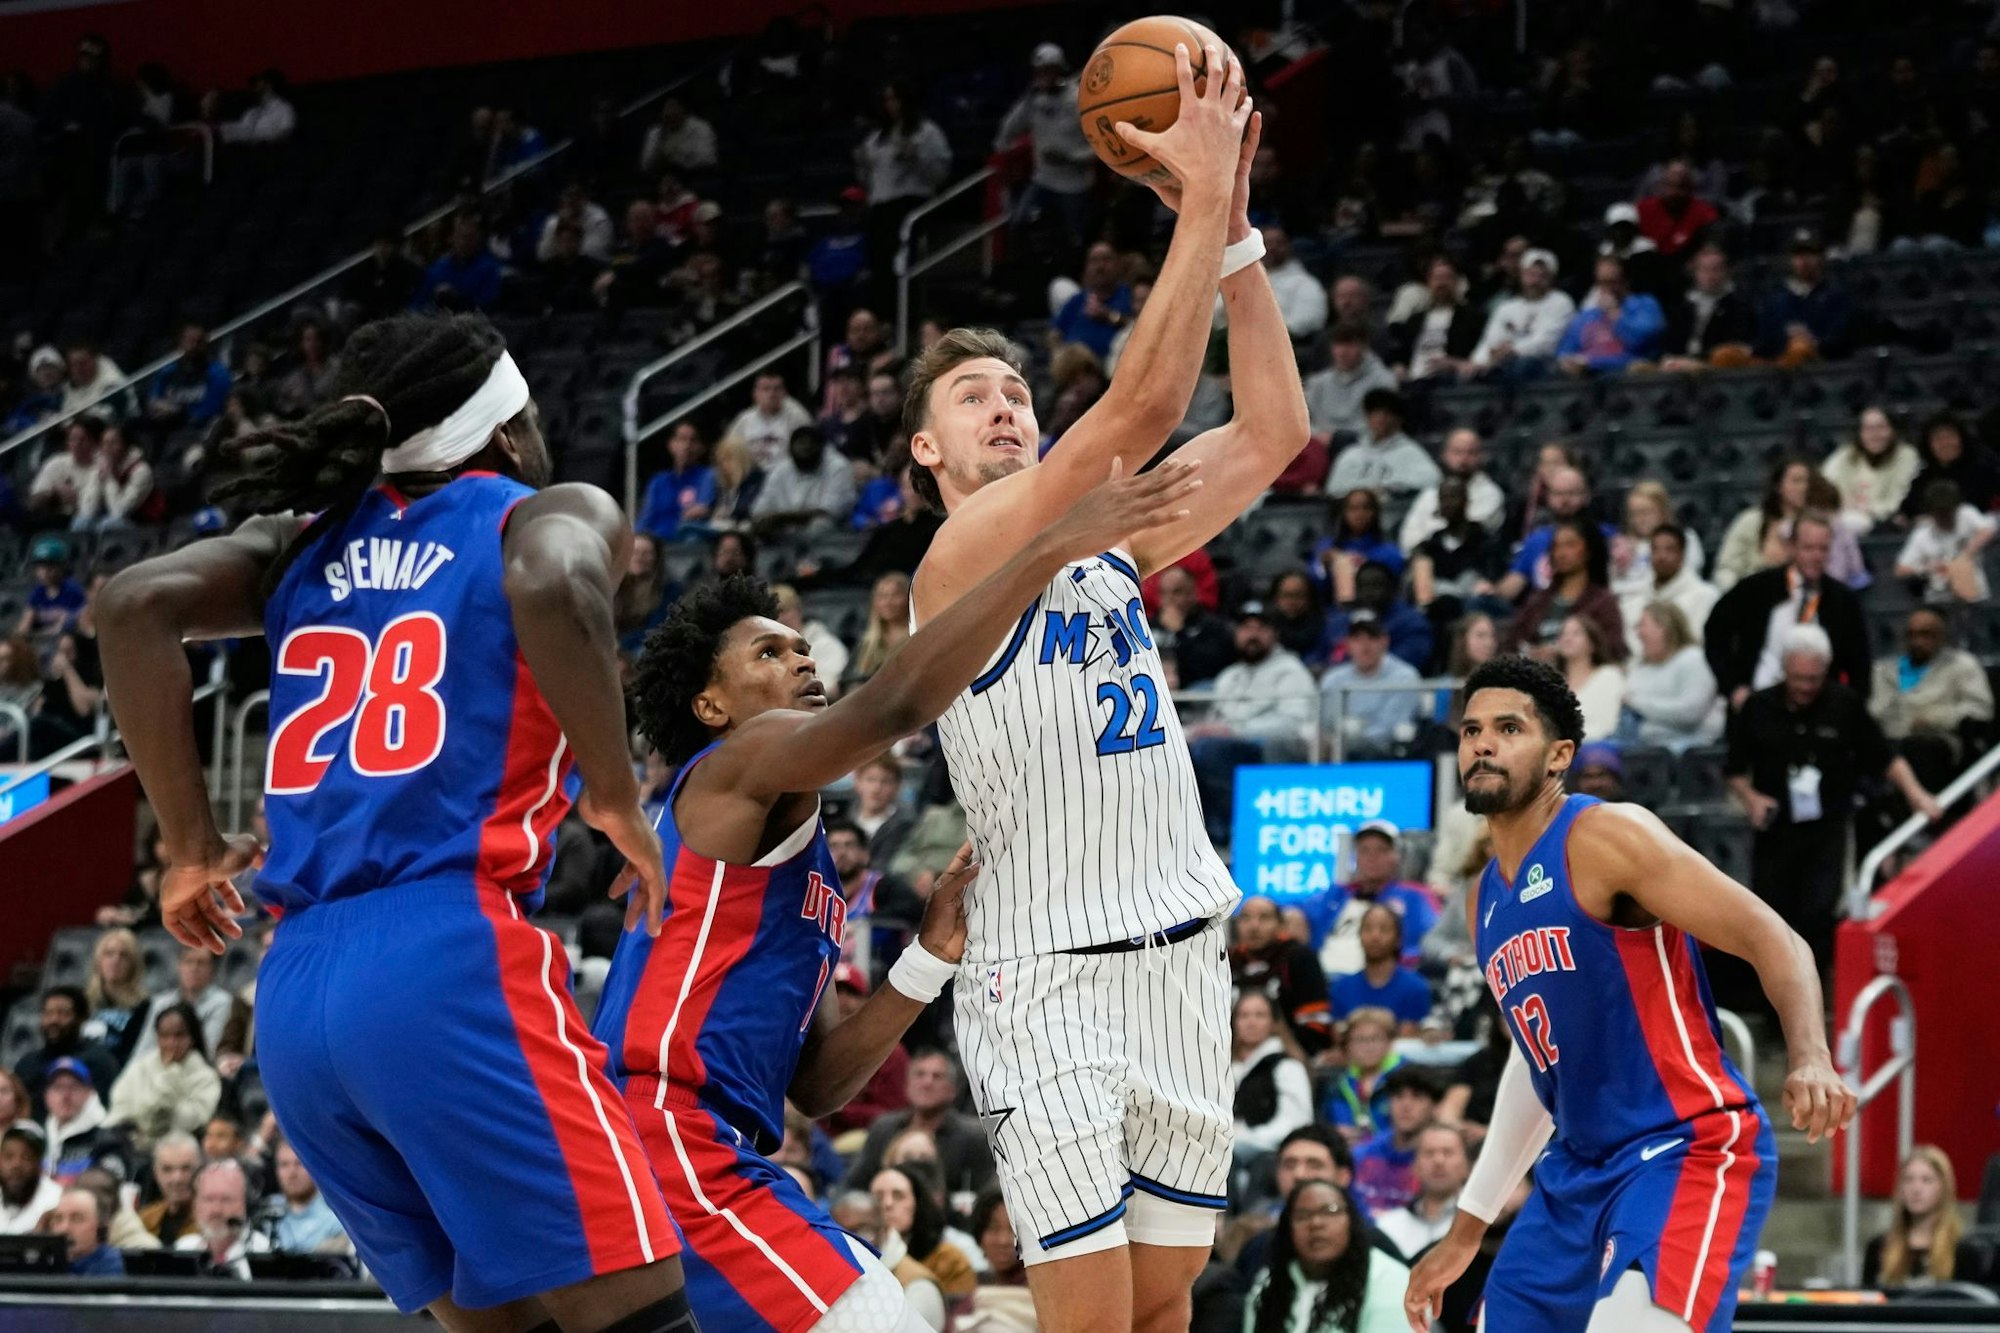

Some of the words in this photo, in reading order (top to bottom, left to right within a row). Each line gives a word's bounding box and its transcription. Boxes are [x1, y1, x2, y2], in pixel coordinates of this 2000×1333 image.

[1039, 597, 1152, 674] MIC
[264, 611, 447, 795] 28
[1096, 673, 1166, 757] 22
[1254, 786, 1384, 819] HENRY
[1256, 861, 1331, 893] HEA
[1510, 993, 1560, 1073] 12
